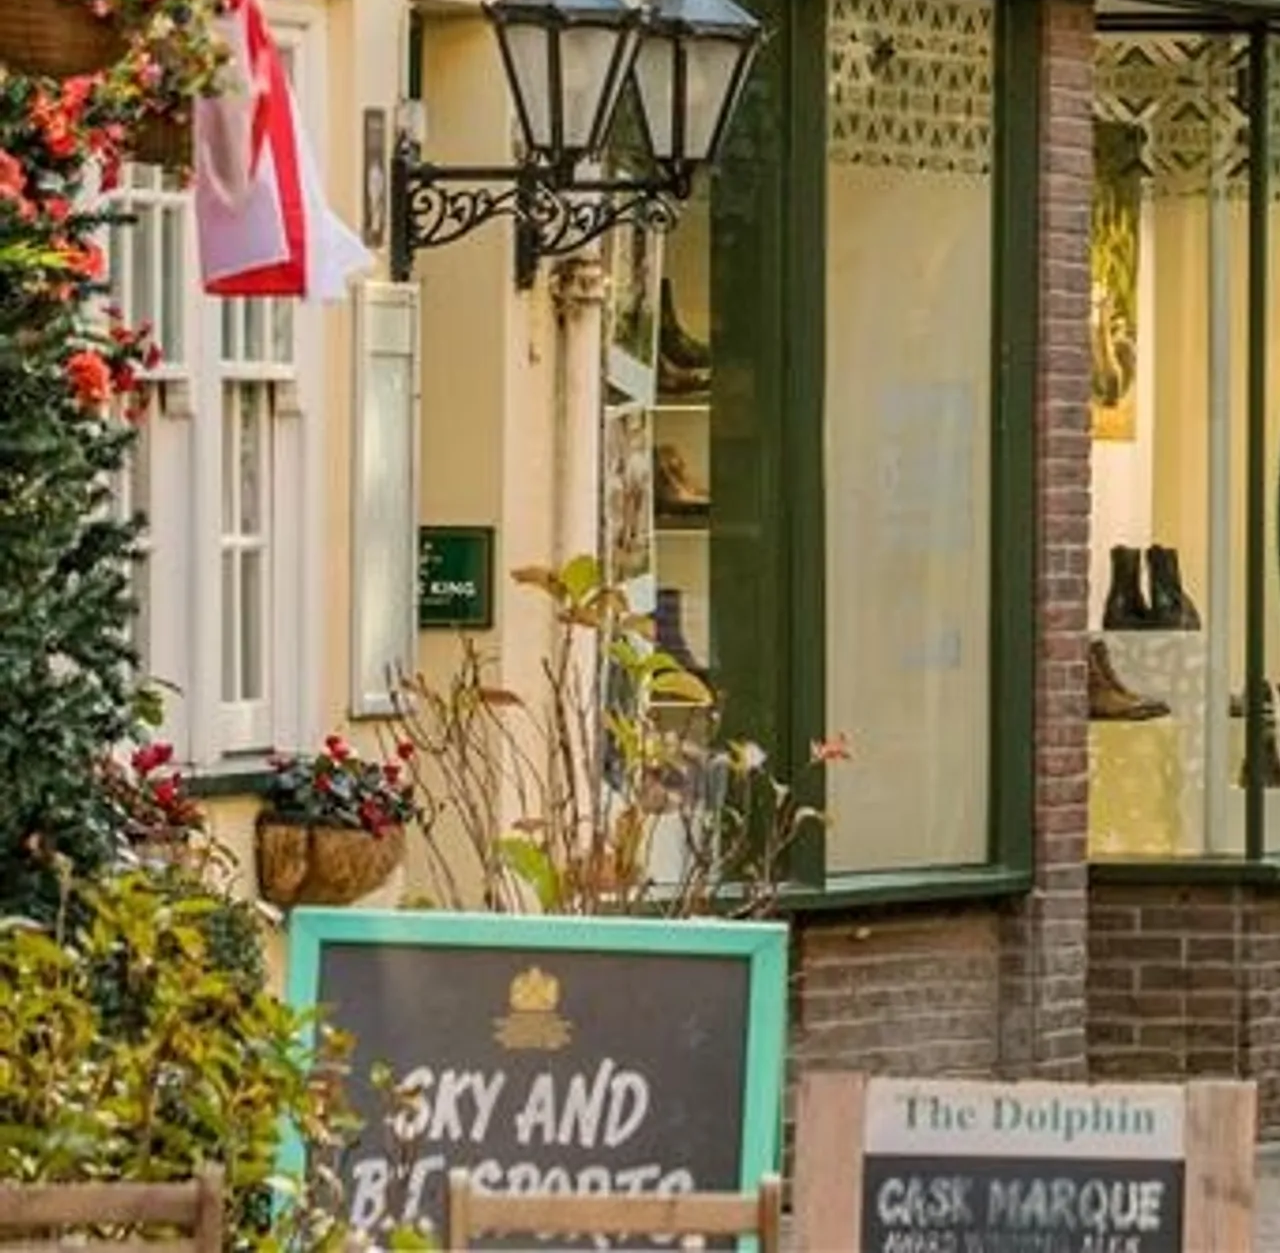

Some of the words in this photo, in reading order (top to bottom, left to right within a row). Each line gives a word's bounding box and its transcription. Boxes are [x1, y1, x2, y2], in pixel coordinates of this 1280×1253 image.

[390, 1064, 506, 1144] SKY
[515, 1056, 651, 1149] AND
[894, 1093, 977, 1132] The
[992, 1093, 1157, 1142] Dolphin
[876, 1176, 973, 1228] CASK
[987, 1177, 1166, 1234] MARQUE
